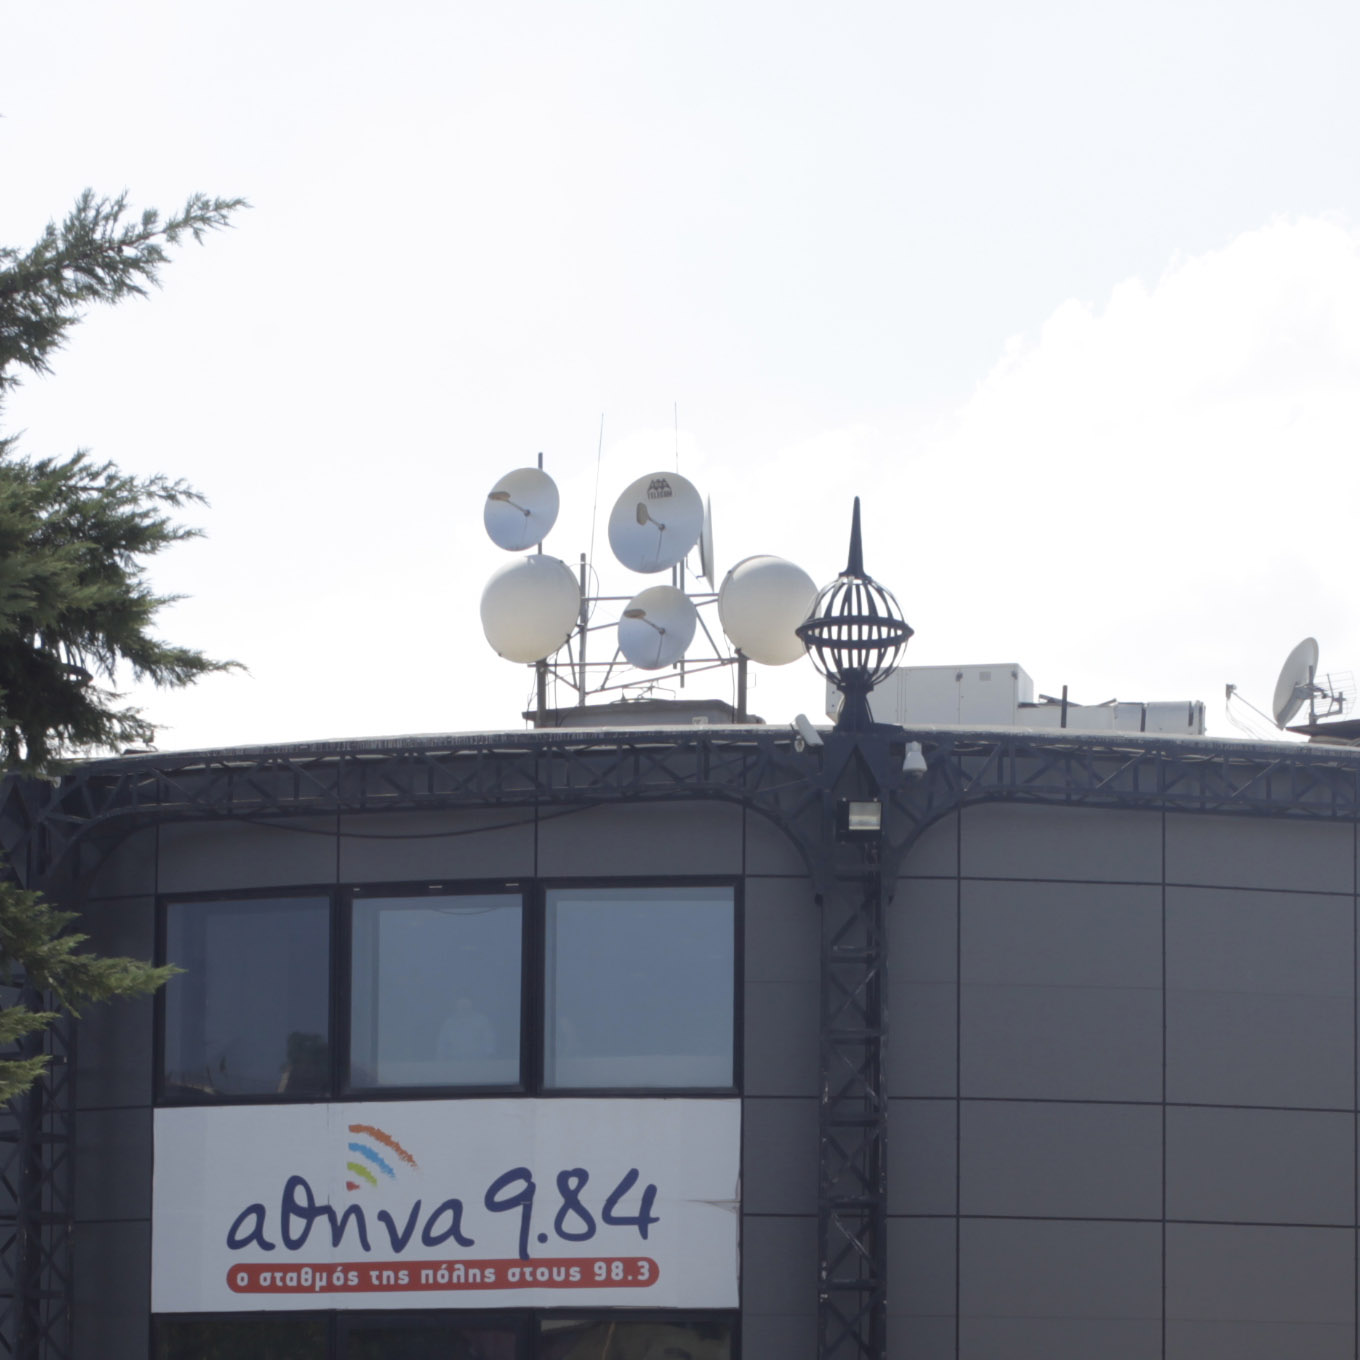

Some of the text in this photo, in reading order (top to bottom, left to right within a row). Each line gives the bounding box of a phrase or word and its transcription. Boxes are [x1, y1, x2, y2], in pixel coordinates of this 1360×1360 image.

[484, 1167, 660, 1260] 9.84
[236, 1260, 650, 1291] ο σταθμός της πόλης στους 98.3
